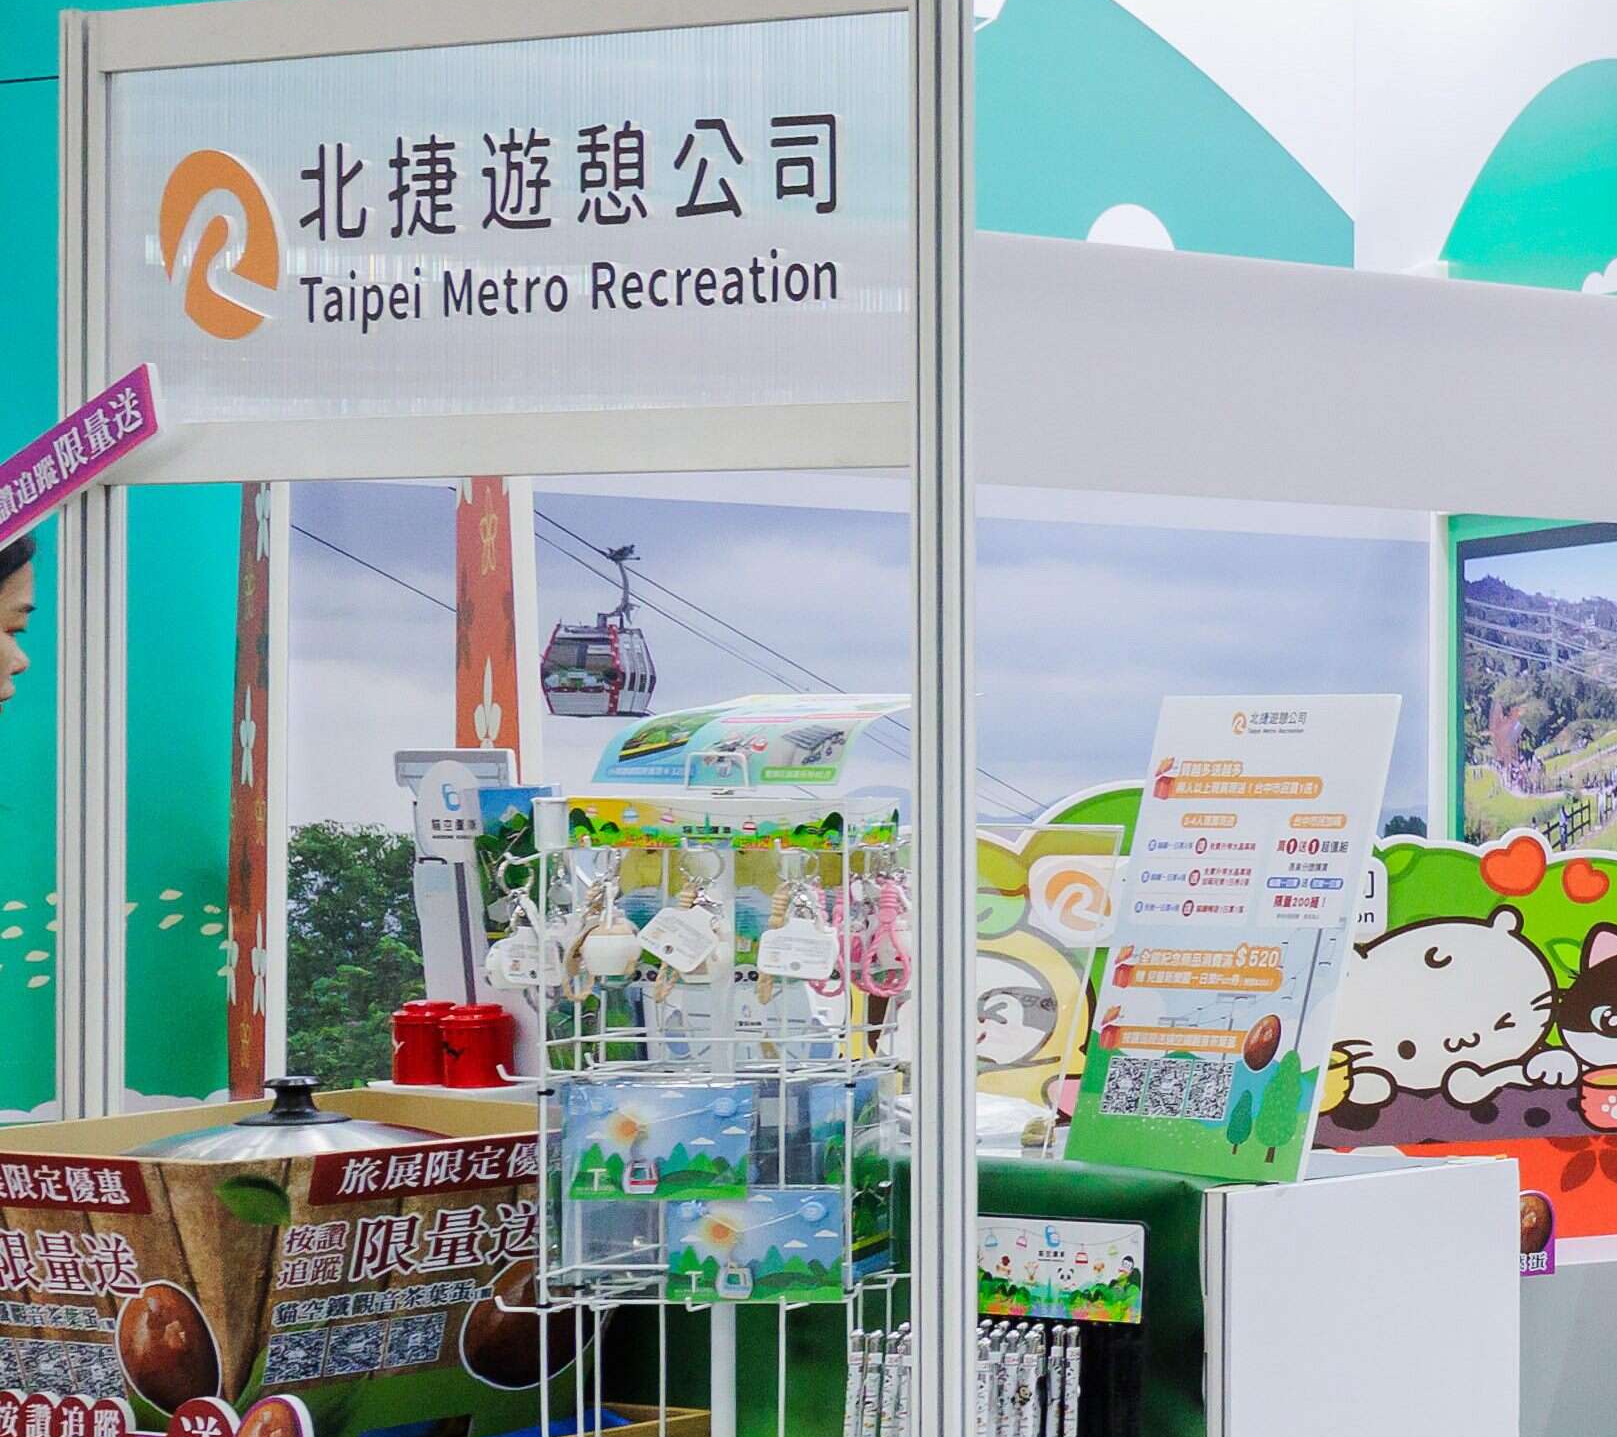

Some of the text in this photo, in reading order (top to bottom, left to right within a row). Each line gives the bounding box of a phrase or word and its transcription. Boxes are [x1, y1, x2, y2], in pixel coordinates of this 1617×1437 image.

[300, 113, 839, 242] 北捷遊憩公司
[301, 248, 839, 335] Taipei Metro Recreation
[336, 1141, 562, 1196] 旅展限定優
